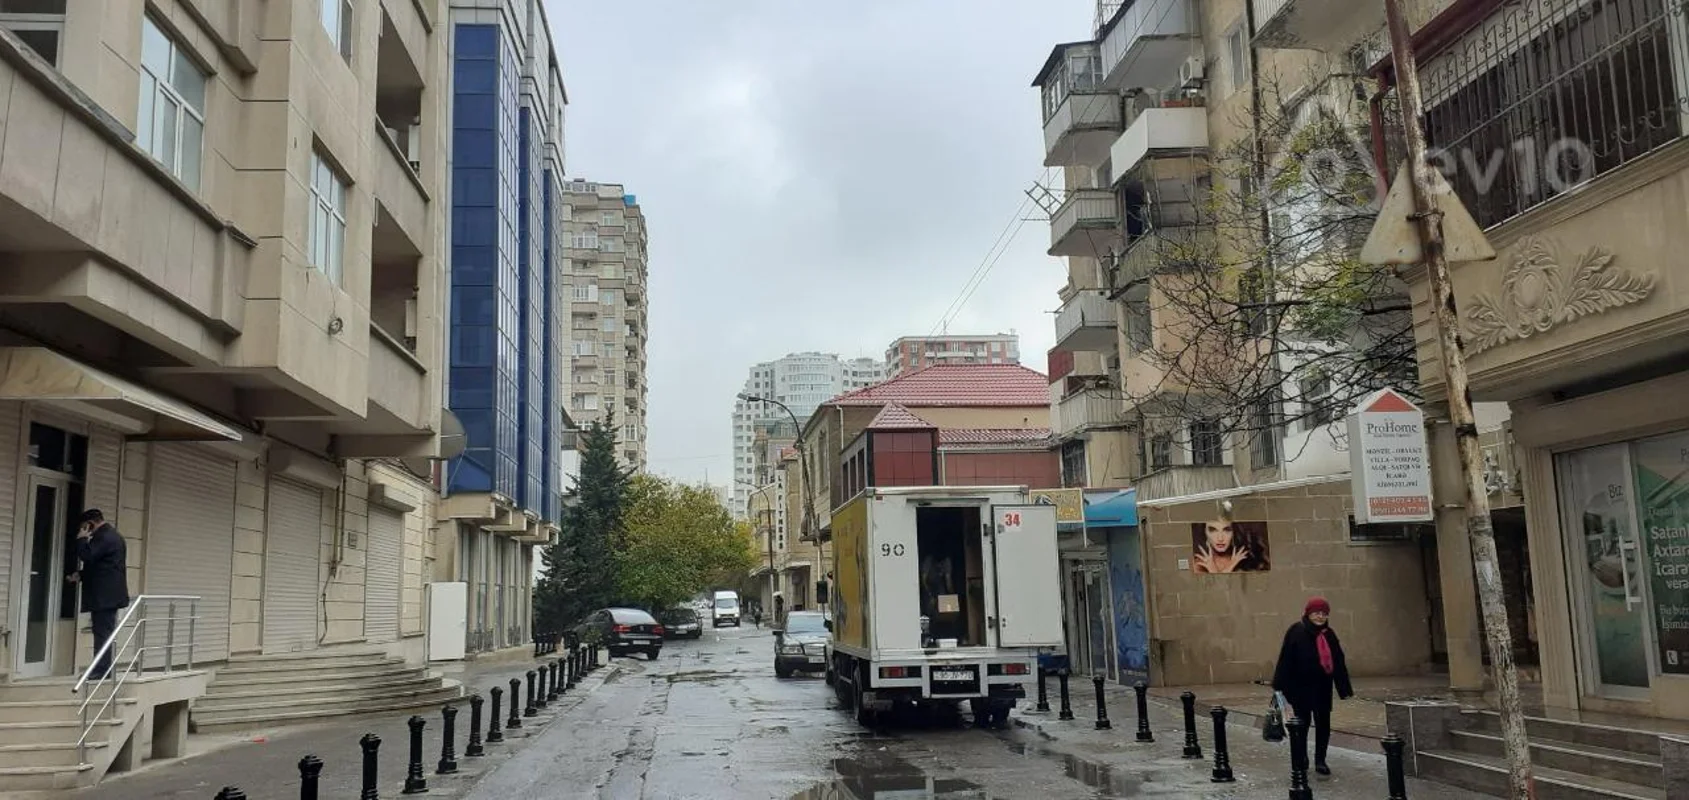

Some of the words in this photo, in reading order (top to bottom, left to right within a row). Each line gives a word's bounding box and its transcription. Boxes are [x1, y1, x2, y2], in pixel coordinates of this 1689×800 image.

[1366, 421, 1417, 434] ProHome
[1005, 513, 1020, 526] 34
[881, 543, 905, 557] 90
